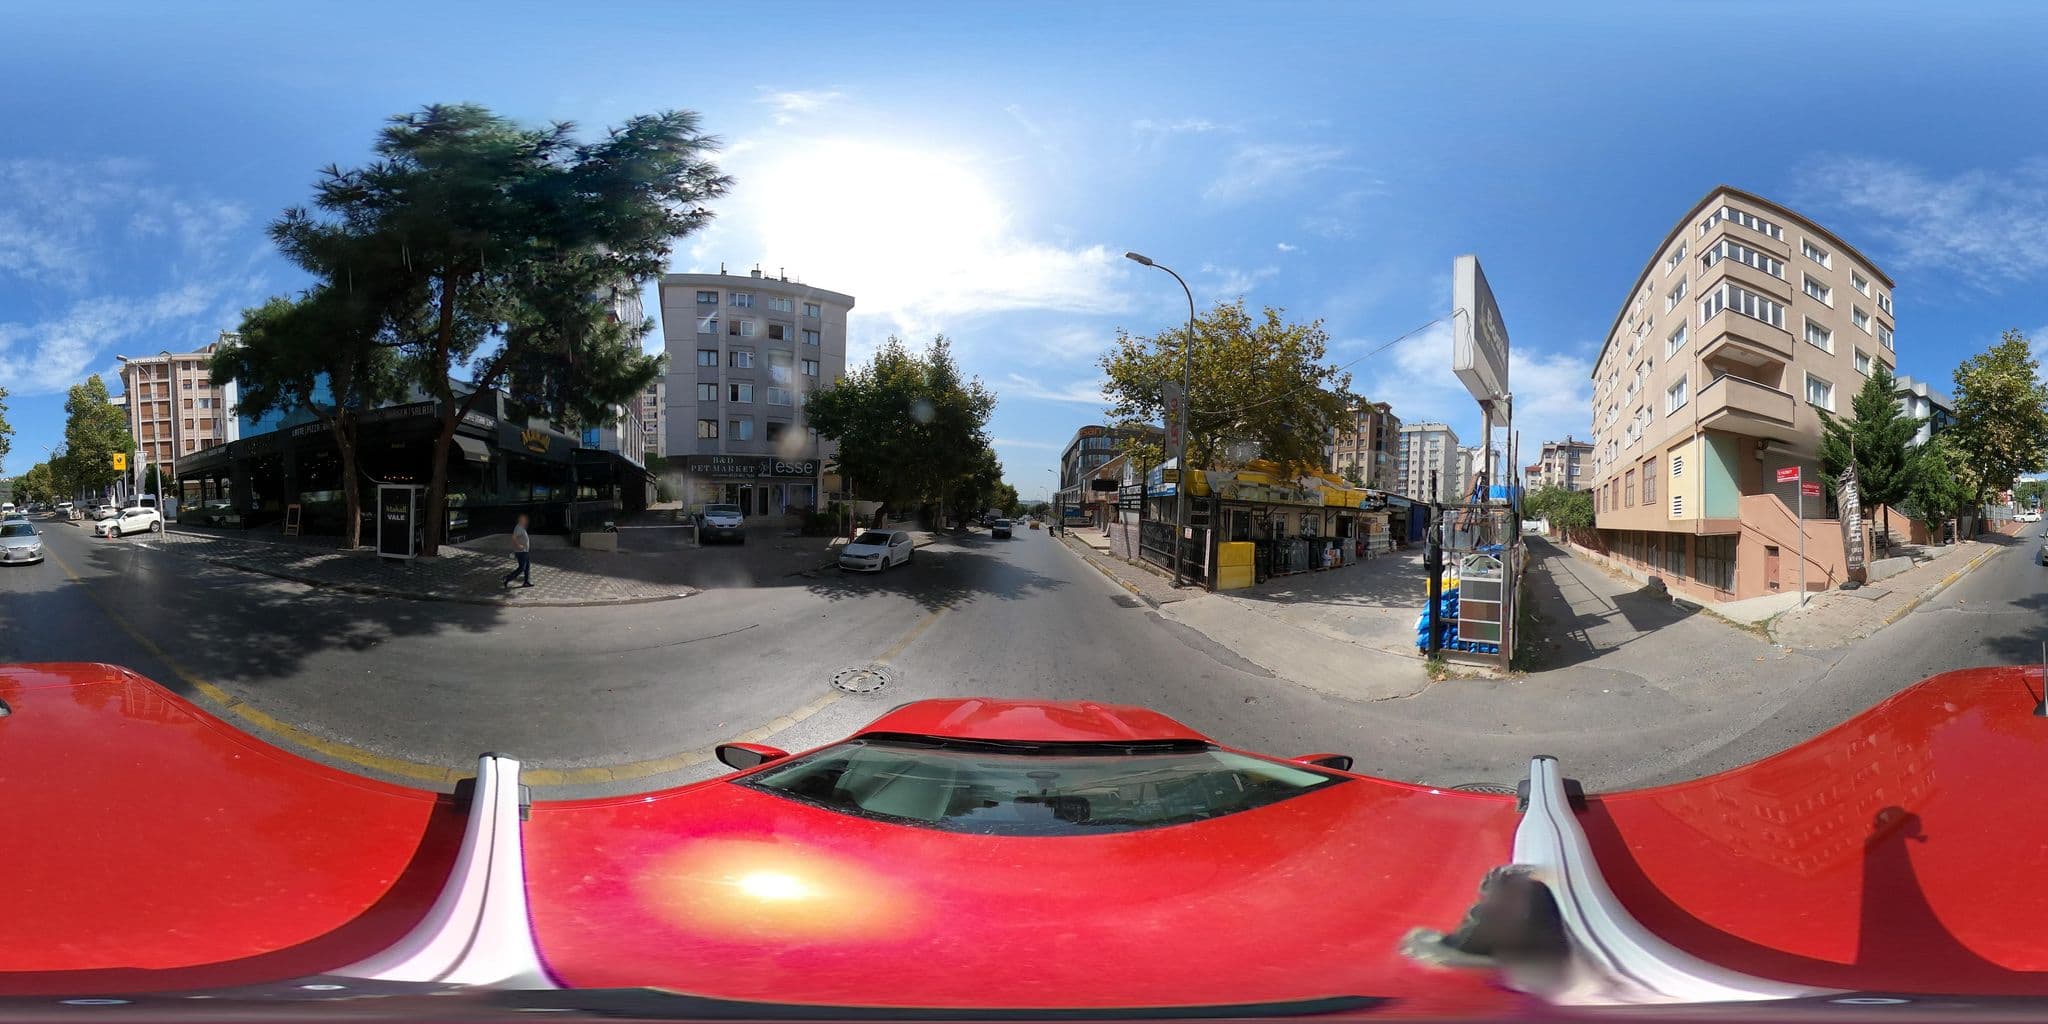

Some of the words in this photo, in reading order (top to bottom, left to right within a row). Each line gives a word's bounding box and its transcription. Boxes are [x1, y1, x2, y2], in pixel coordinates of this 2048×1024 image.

[691, 464, 710, 472] PET
[712, 465, 755, 473] MARKET
[775, 461, 813, 474] esse
